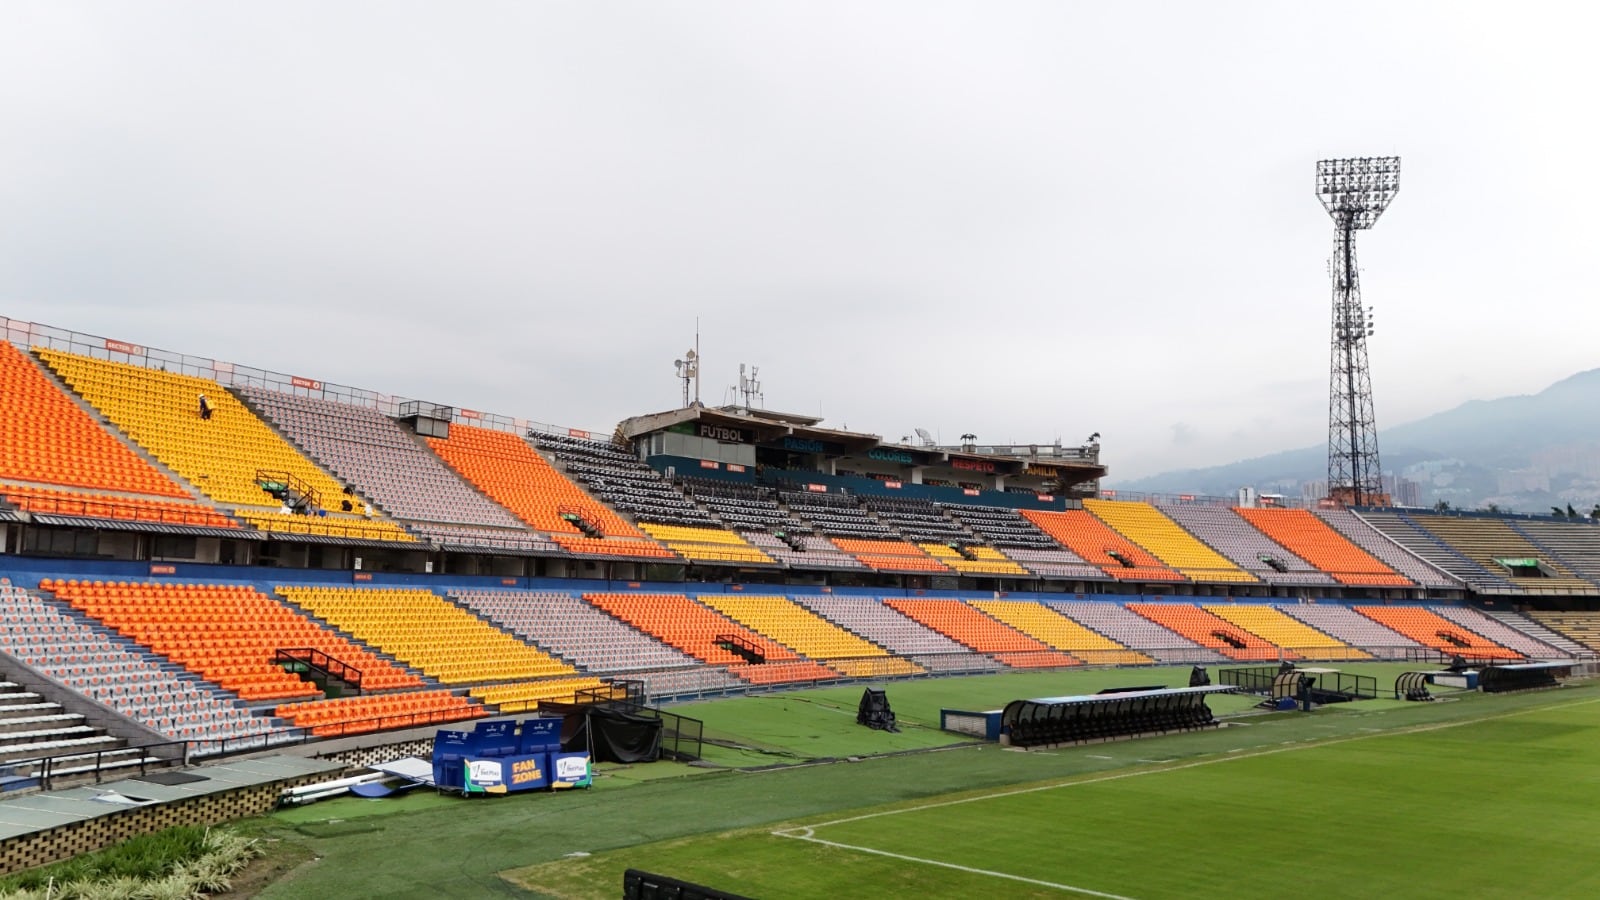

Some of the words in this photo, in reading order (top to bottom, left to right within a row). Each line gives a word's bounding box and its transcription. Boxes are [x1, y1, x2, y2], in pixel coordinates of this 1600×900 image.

[868, 450, 913, 464] COLORES
[952, 457, 995, 473] RESPETO
[512, 759, 535, 772] FAN
[512, 769, 542, 785] ZONE
